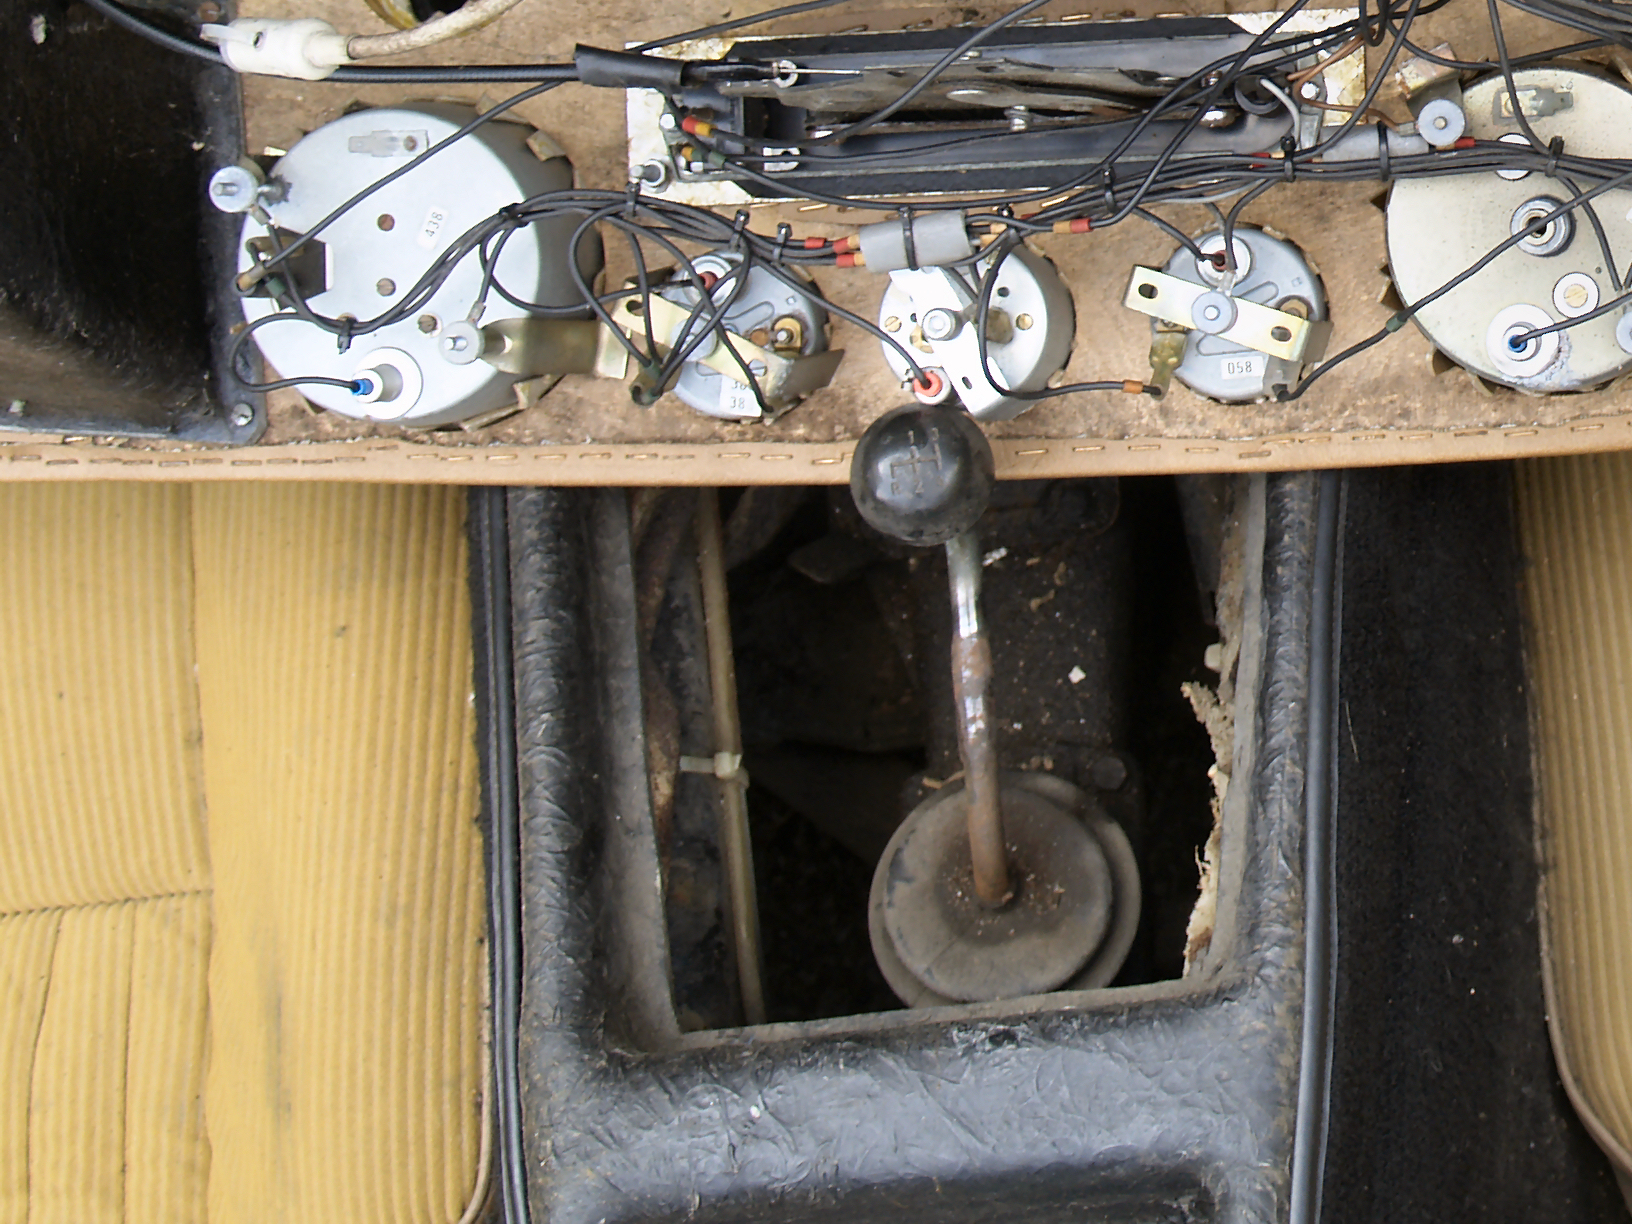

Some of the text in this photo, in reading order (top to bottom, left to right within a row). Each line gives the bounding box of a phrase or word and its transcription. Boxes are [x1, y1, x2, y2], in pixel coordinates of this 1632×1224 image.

[425, 212, 443, 237] 438
[1227, 360, 1252, 375] 058
[729, 396, 745, 409] 38
